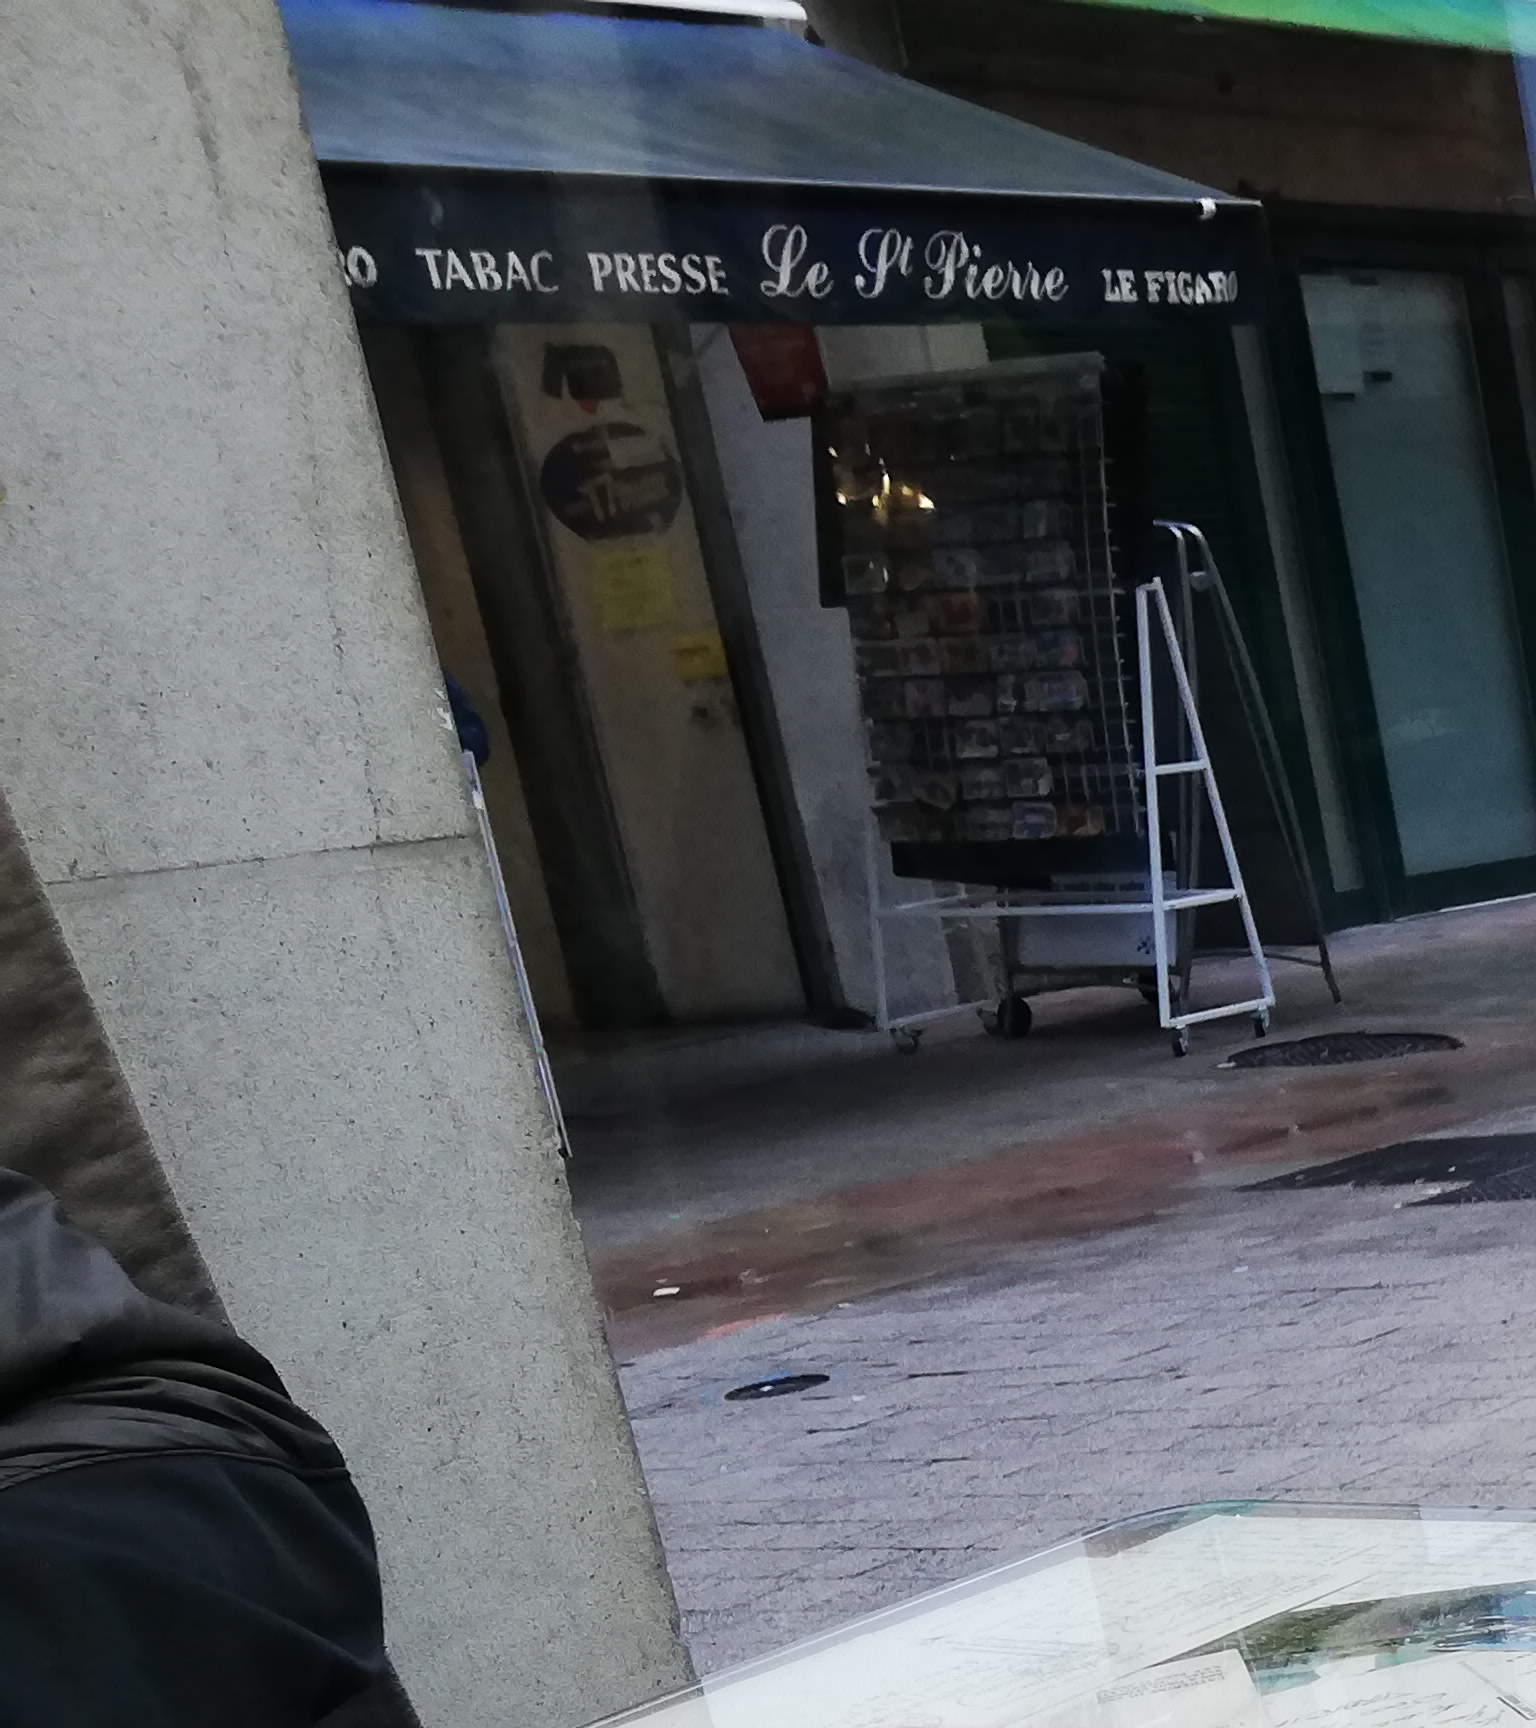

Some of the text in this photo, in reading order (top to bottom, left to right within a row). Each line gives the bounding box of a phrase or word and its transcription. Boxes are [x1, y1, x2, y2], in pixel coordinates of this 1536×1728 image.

[415, 247, 560, 294] TABAC
[587, 250, 730, 296] PRESSE
[760, 223, 835, 300] Le
[924, 228, 1069, 301] Pierre
[1101, 267, 1138, 303] LE
[1143, 269, 1239, 304] FIGARO
